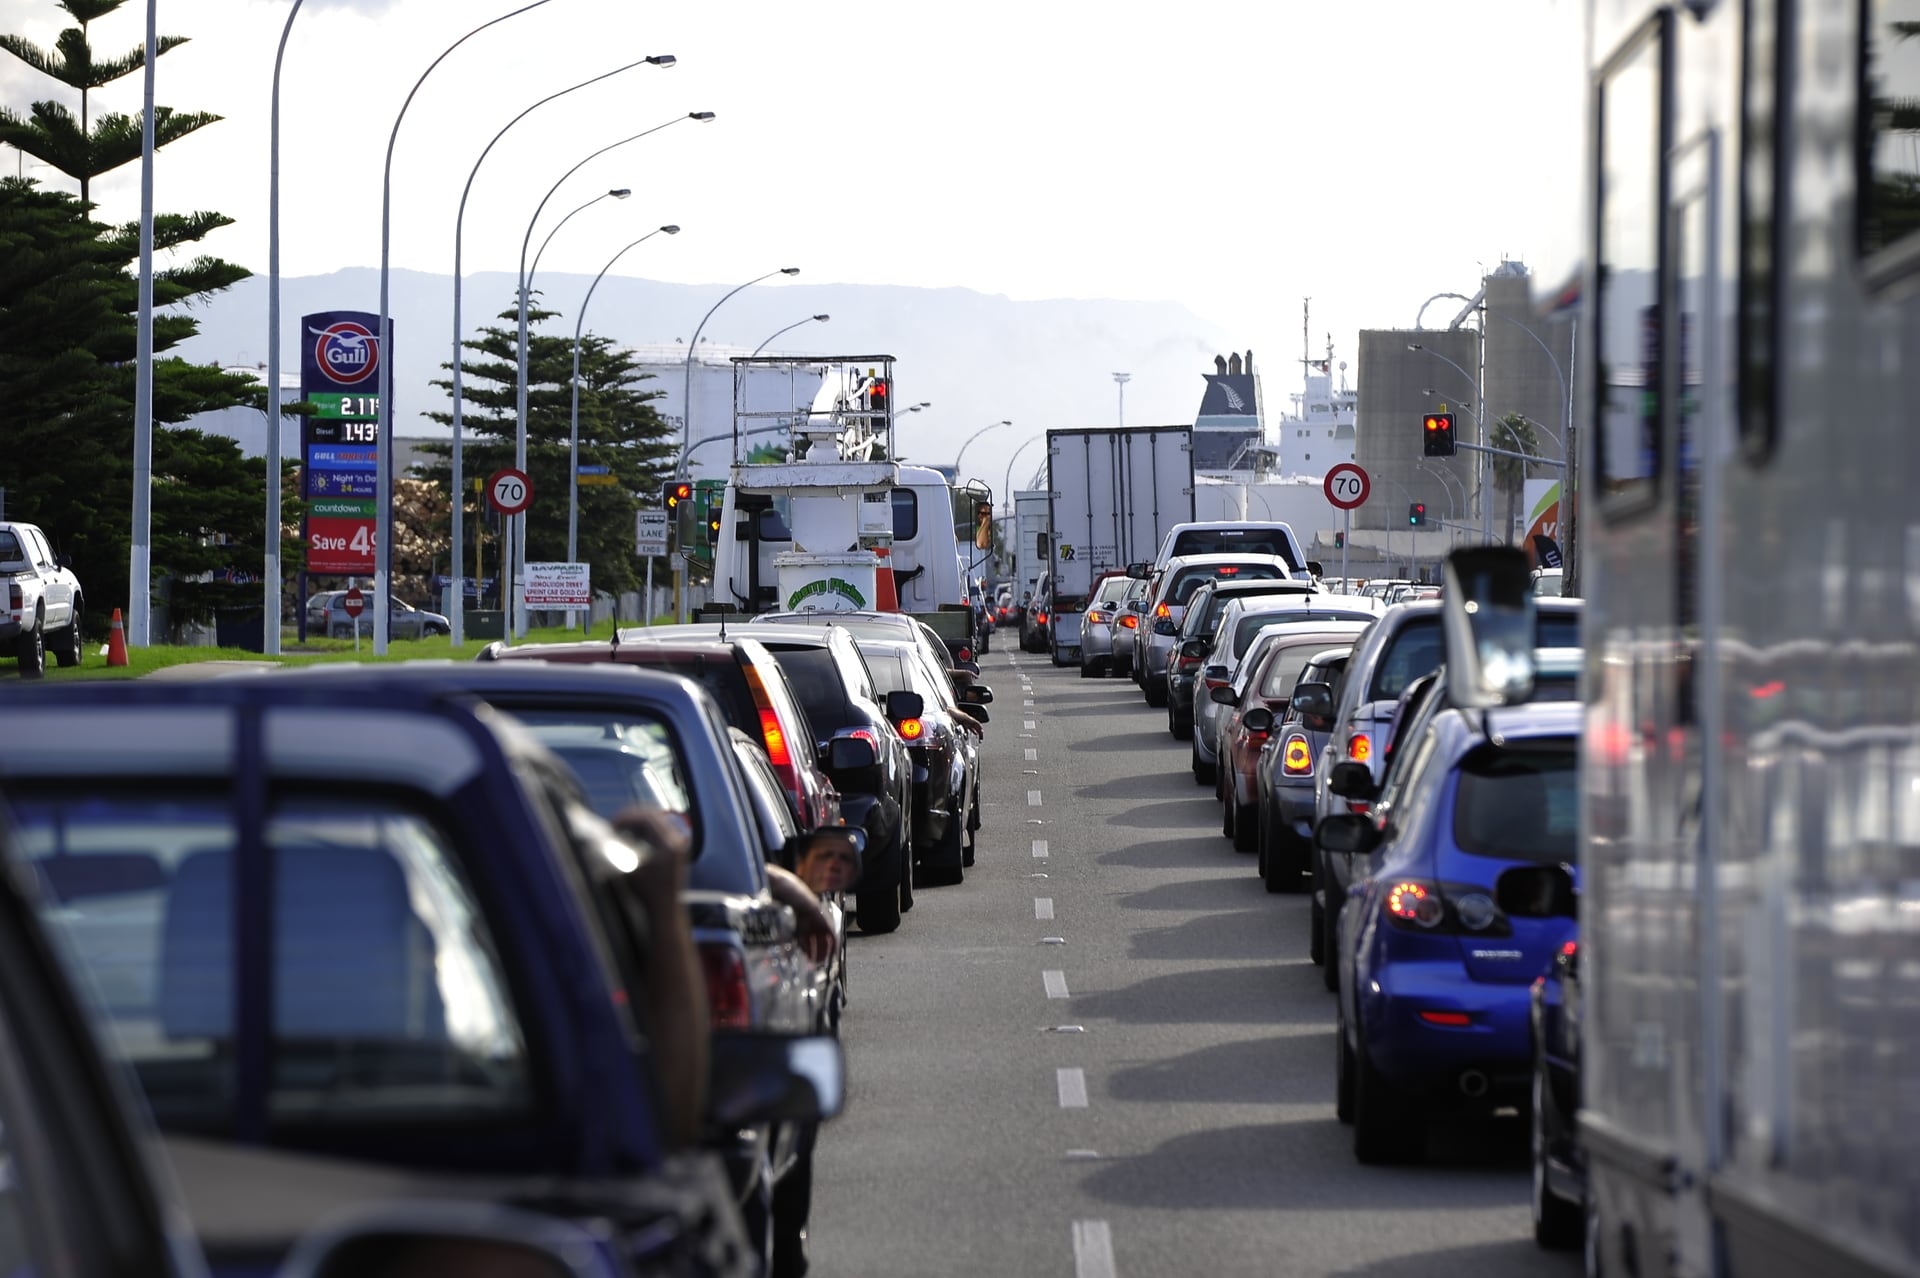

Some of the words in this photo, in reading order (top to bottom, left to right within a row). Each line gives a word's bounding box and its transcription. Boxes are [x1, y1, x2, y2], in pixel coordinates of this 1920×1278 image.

[327, 347, 366, 365] Gull
[315, 427, 334, 435] Diesel
[333, 474, 353, 484] Night
[365, 475, 377, 483] Da
[341, 484, 352, 493] 24
[1335, 478, 1360, 495] 70
[498, 483, 523, 501] 70
[314, 504, 361, 513] countdown
[311, 533, 346, 550] Save
[642, 545, 661, 553] ENDS
